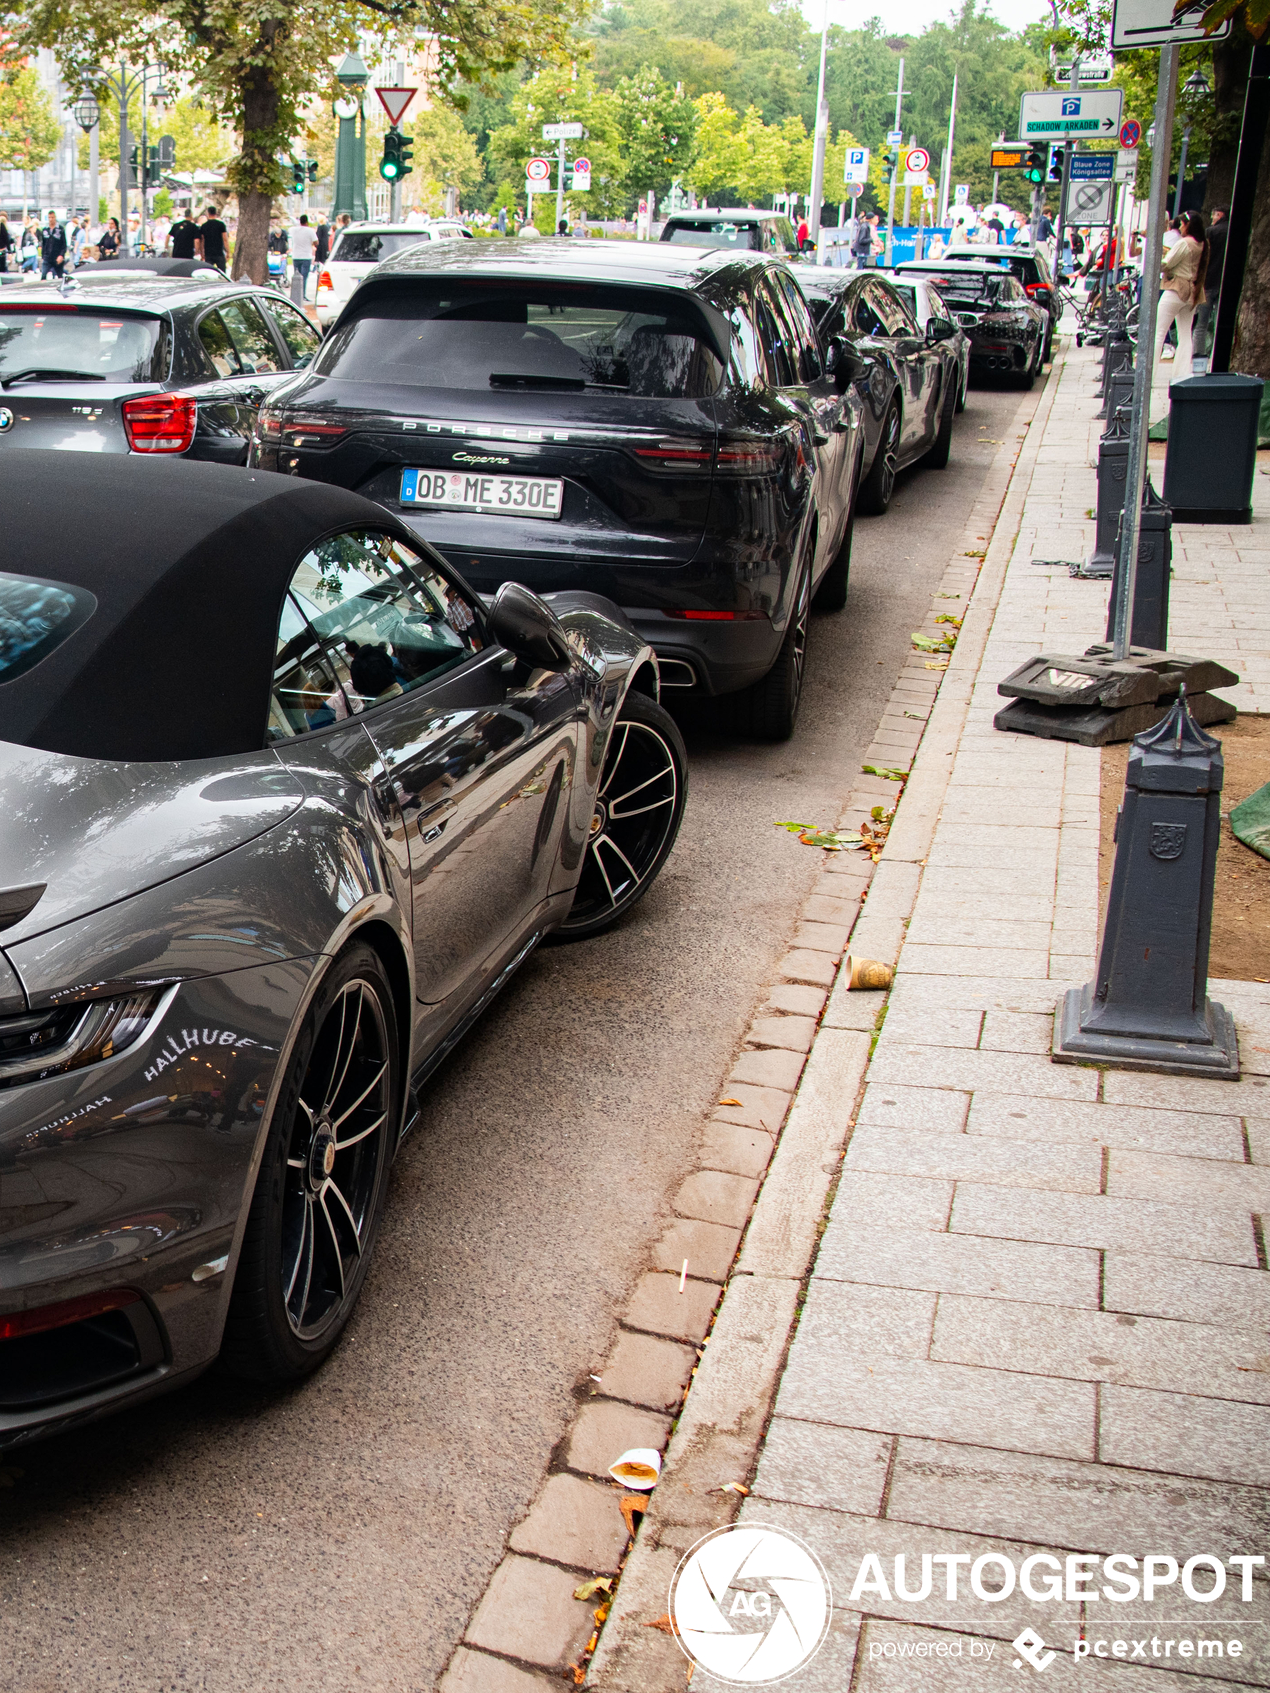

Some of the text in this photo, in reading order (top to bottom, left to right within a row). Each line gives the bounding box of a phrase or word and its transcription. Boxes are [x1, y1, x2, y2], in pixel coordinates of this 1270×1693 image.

[1027, 120, 1099, 132] SCHADOW ARKADEN
[1094, 160, 1111, 168] Zone
[1072, 168, 1111, 176] Königsallee
[1077, 212, 1098, 220] ZONE
[402, 422, 569, 441] PORSCHE
[452, 452, 510, 466] Cayenne
[405, 474, 558, 509] D OB ME 330E
